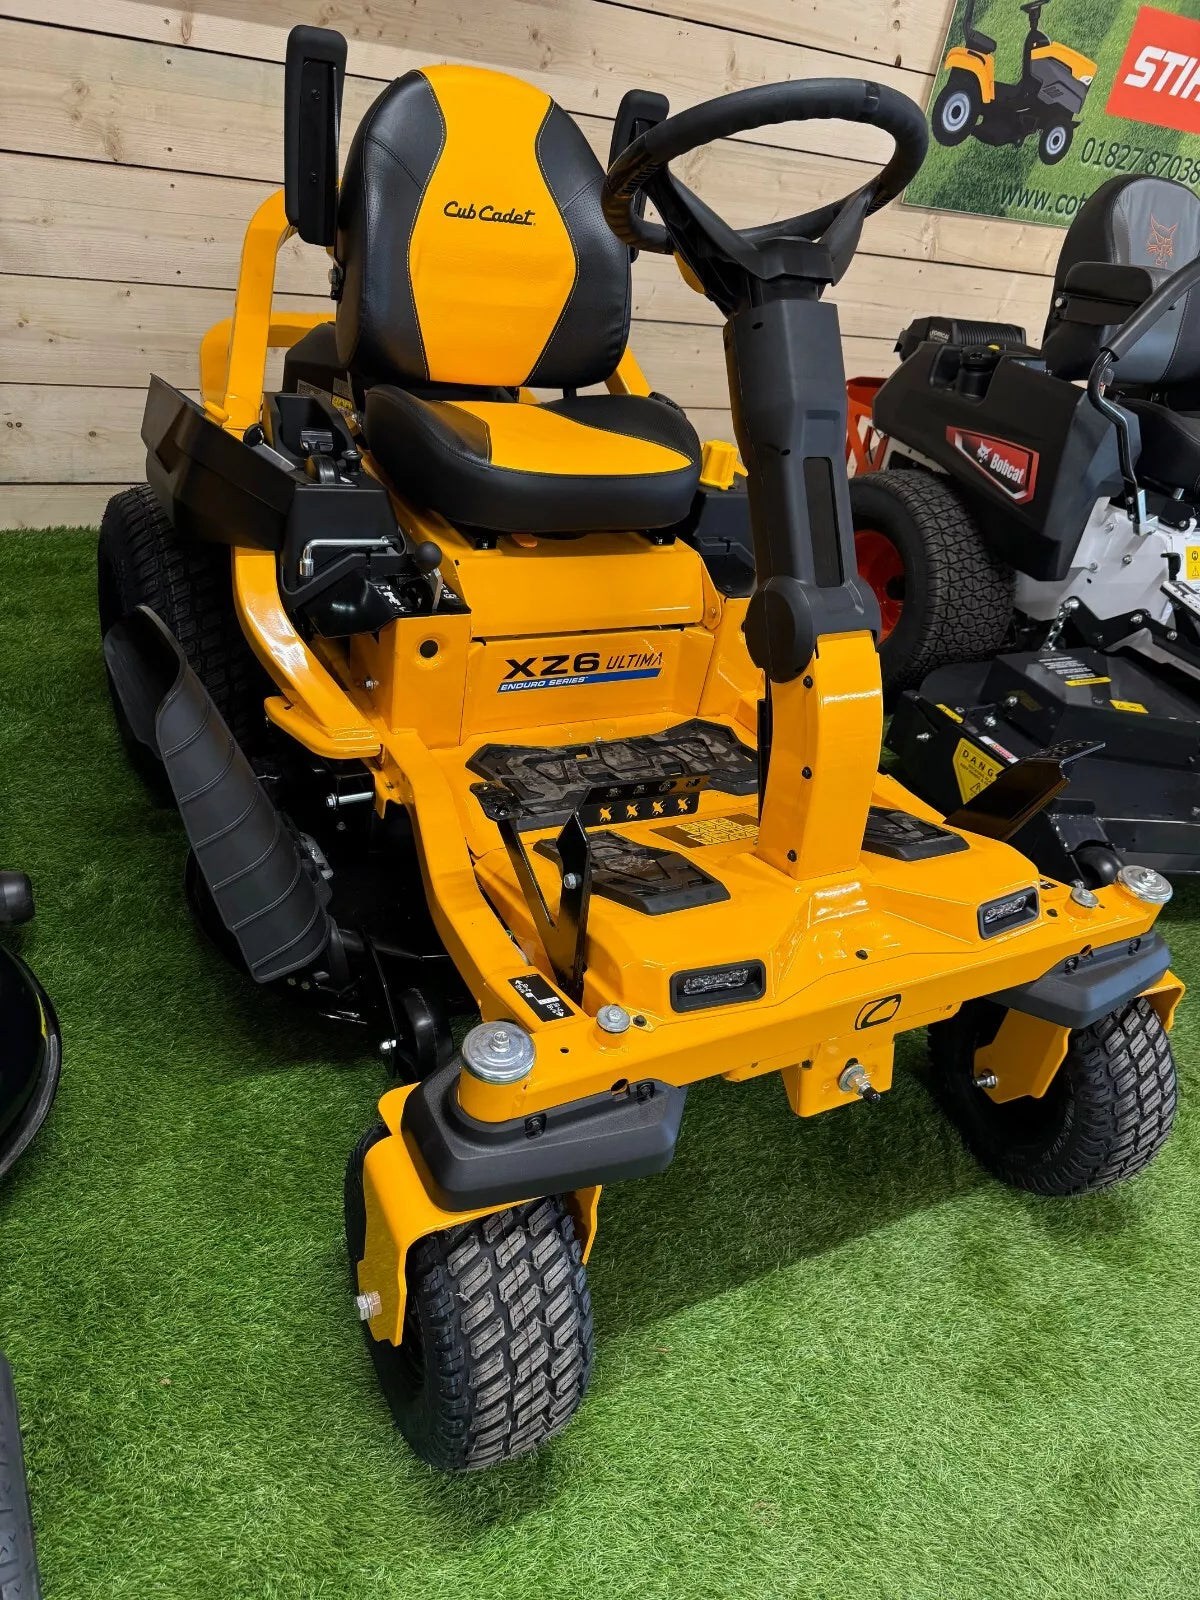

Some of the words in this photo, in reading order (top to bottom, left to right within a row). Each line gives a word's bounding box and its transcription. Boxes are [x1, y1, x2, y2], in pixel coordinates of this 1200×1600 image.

[1081, 137, 1144, 171] 01827
[443, 201, 476, 219] Cub
[478, 205, 535, 225] Cadet
[989, 453, 1025, 484] Bobcat
[503, 652, 600, 680] XZ6
[606, 651, 663, 670] ULTIMA
[500, 680, 546, 691] ENDURO
